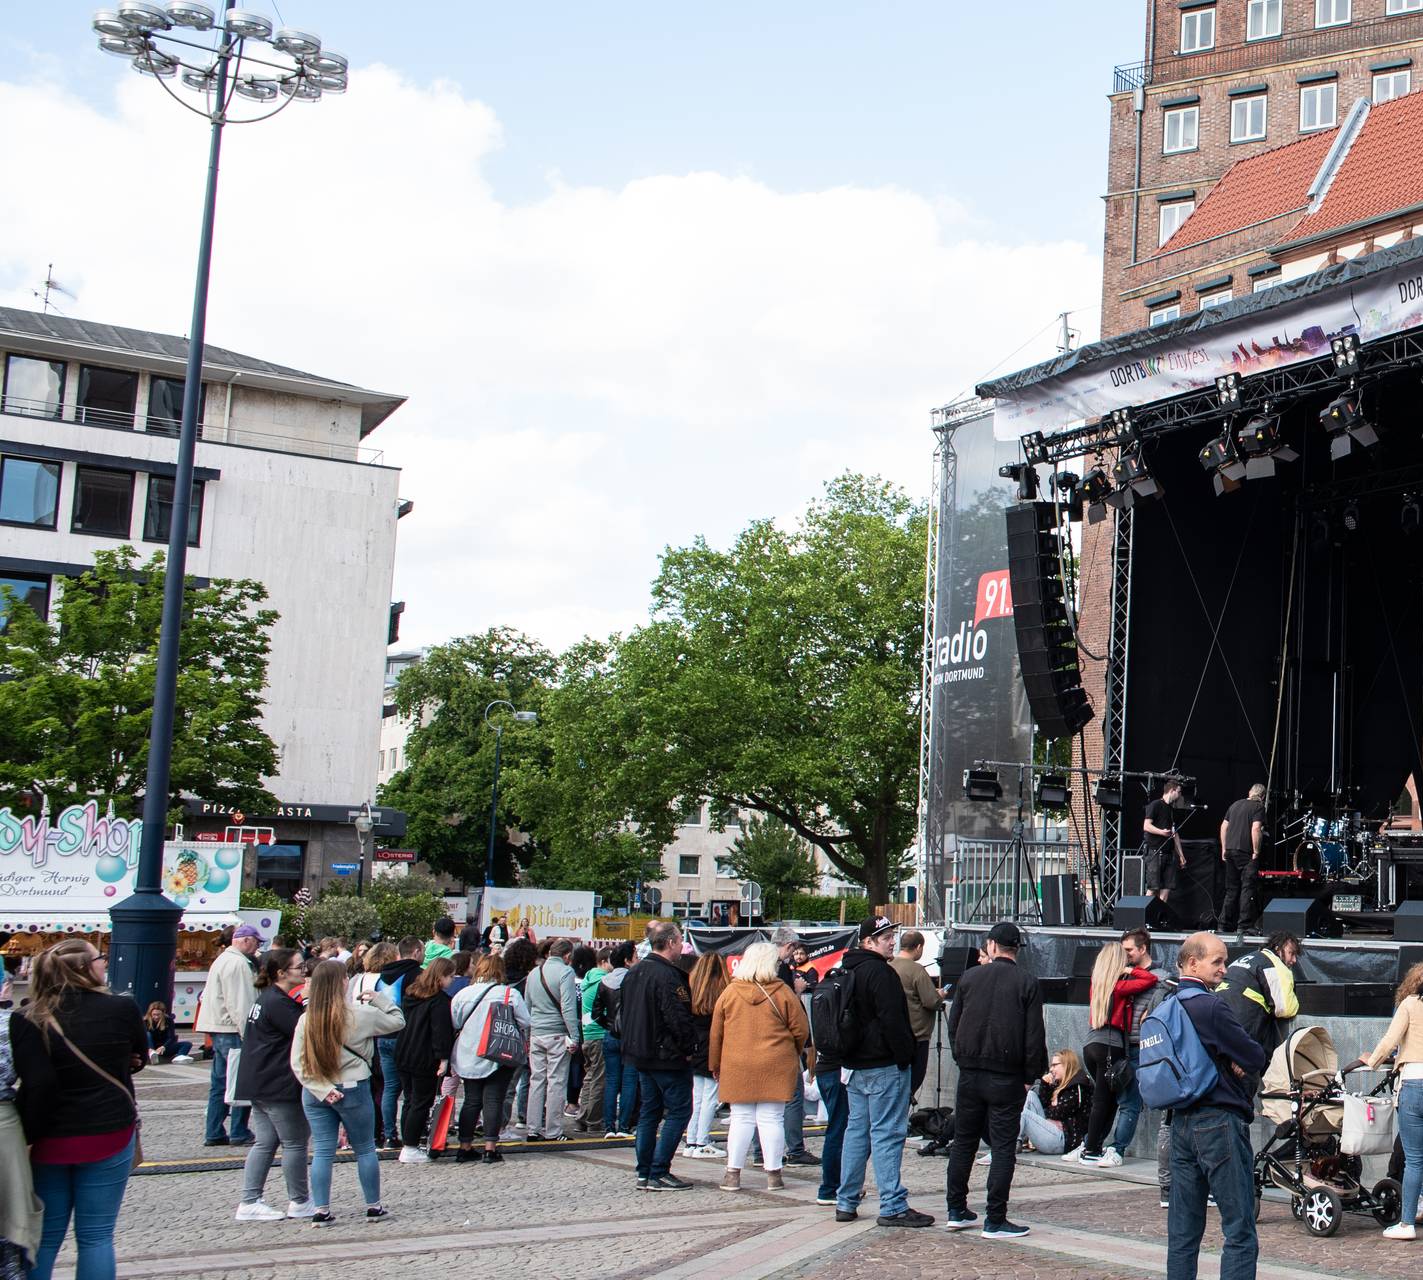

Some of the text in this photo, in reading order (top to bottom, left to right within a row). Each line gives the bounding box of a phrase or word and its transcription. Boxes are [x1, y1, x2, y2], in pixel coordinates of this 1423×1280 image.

[985, 578, 1013, 617] 91.
[934, 620, 988, 668] radio
[945, 667, 985, 683] DORTMUND
[269, 807, 312, 817] ASTA
[41, 870, 90, 885] Hornig
[0, 884, 72, 896] Dortmund
[526, 904, 590, 930] Bitburger
